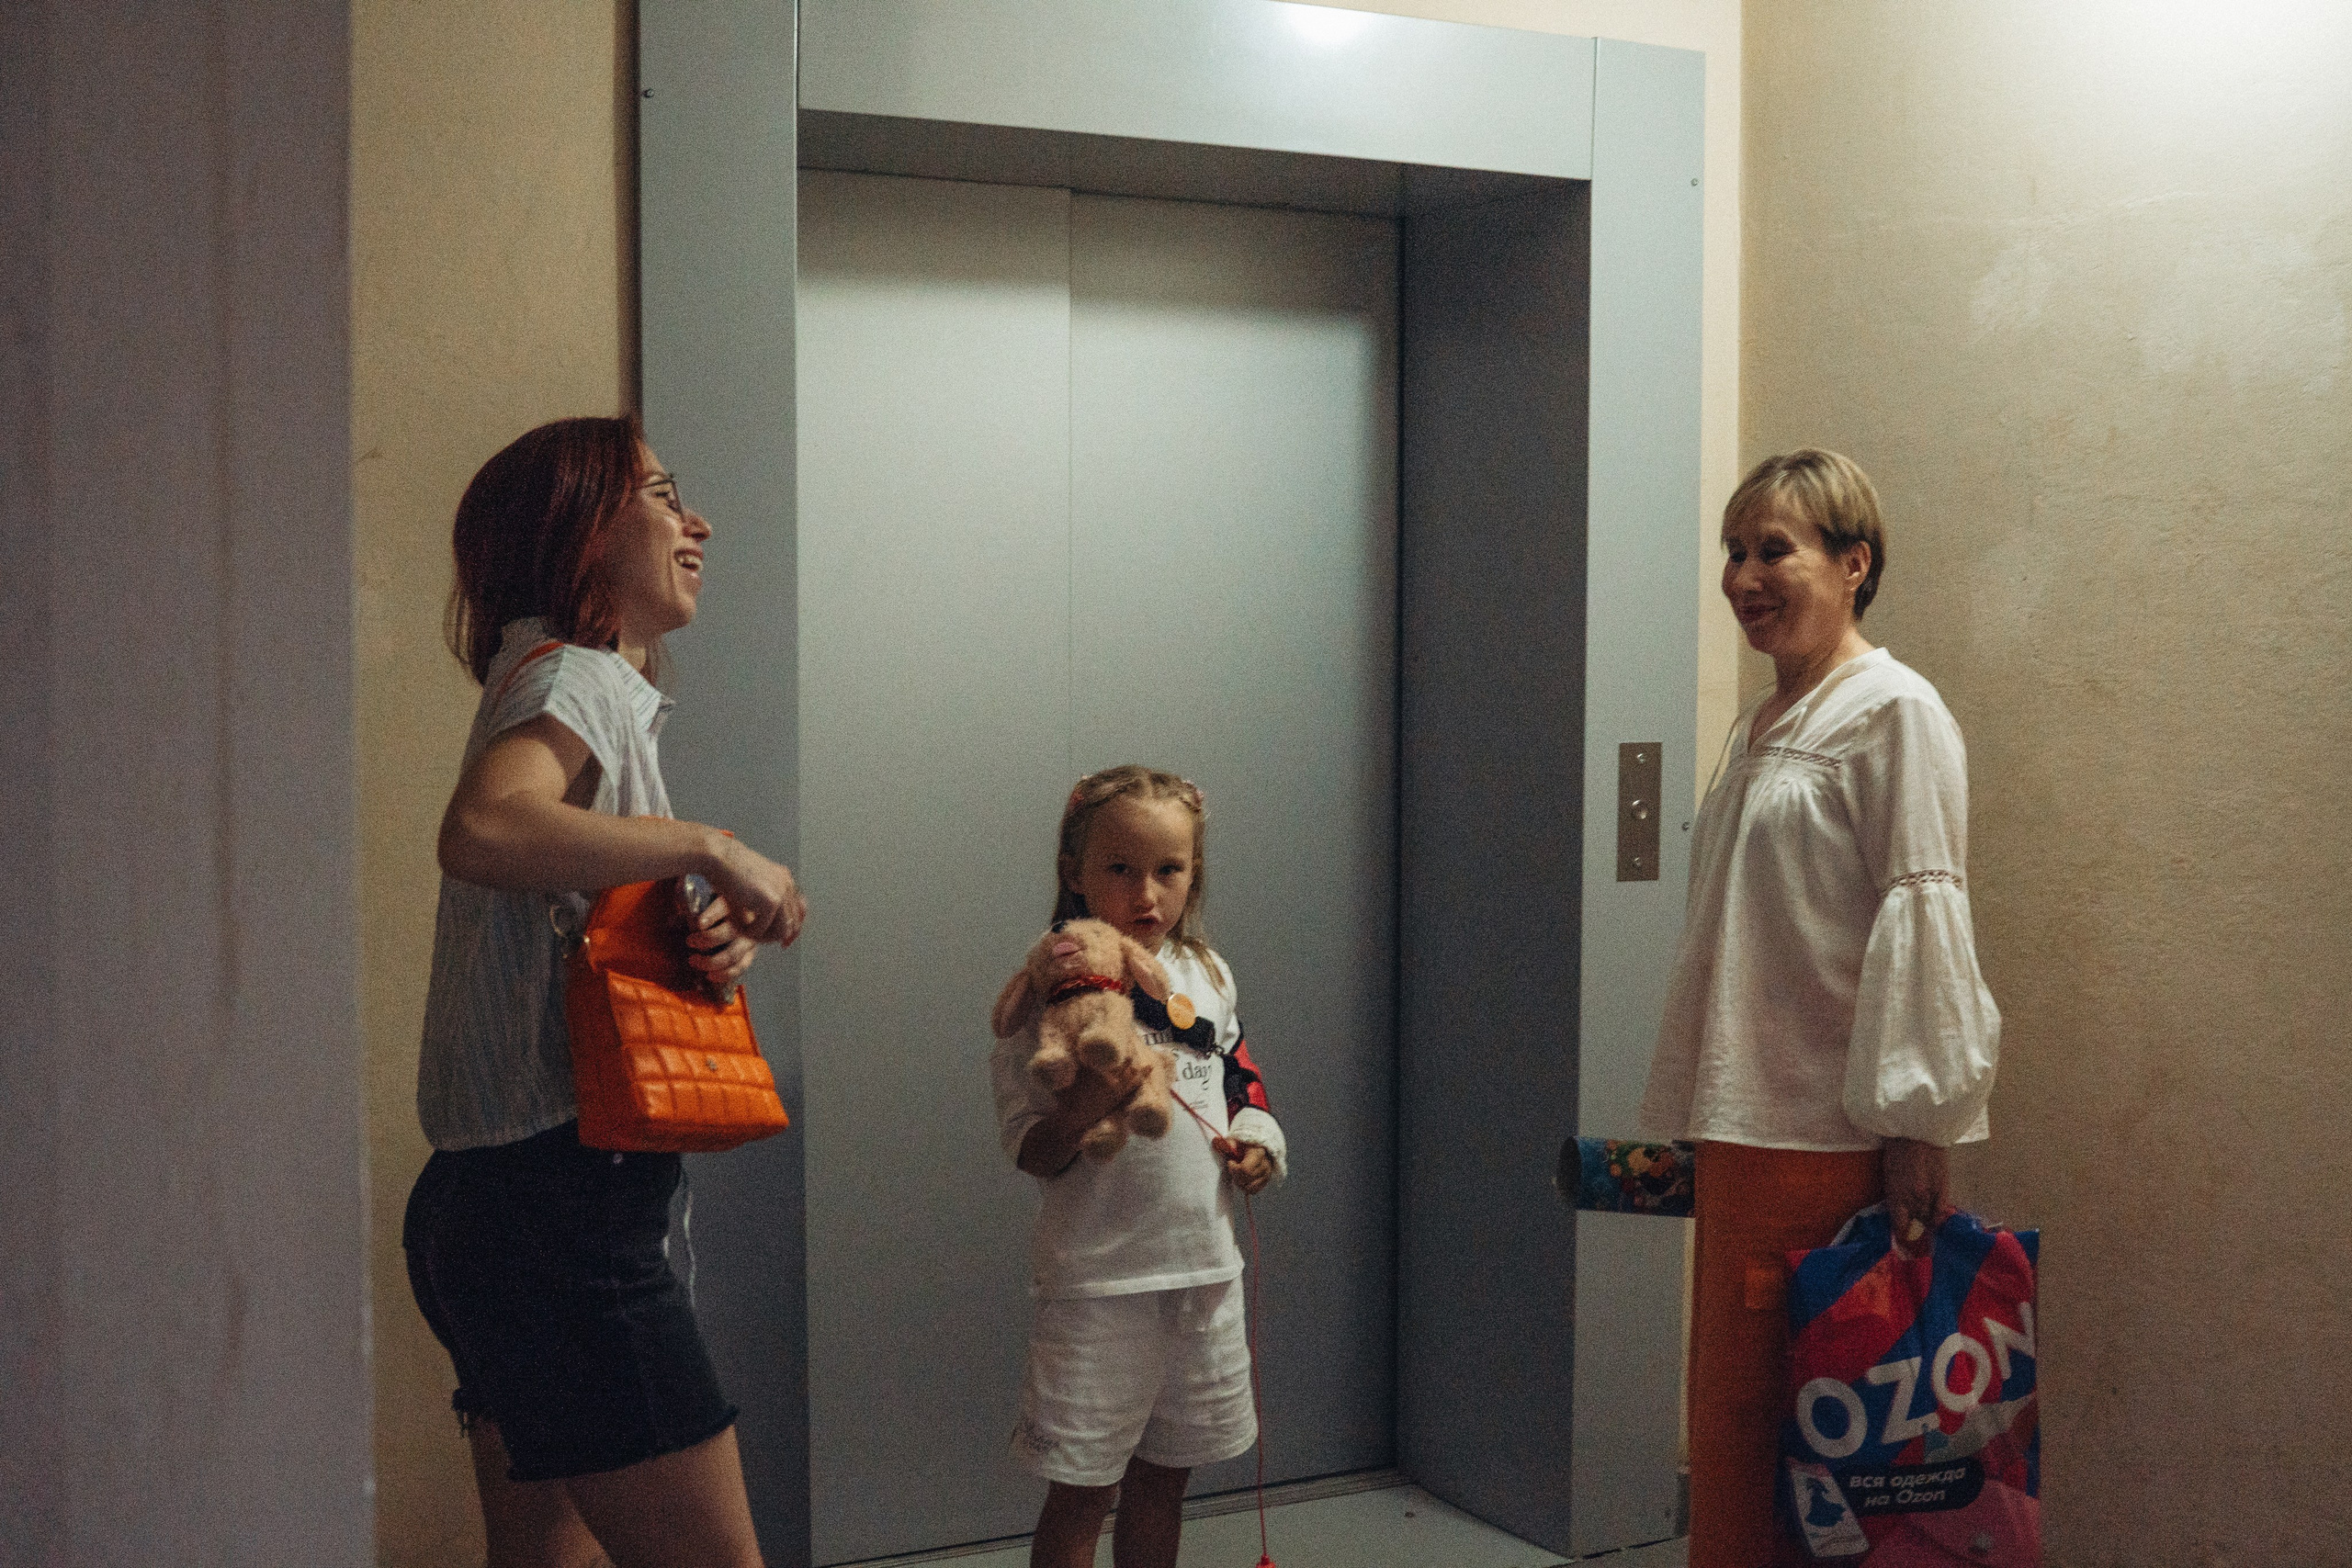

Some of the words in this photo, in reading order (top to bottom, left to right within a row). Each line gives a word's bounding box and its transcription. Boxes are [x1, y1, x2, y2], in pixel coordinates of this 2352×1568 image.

[1796, 1301, 2036, 1459] OZON
[1849, 1474, 1886, 1488] вся
[1890, 1466, 1967, 1489] одежда
[1864, 1494, 1890, 1507] на
[1895, 1488, 1947, 1505] Ozon
